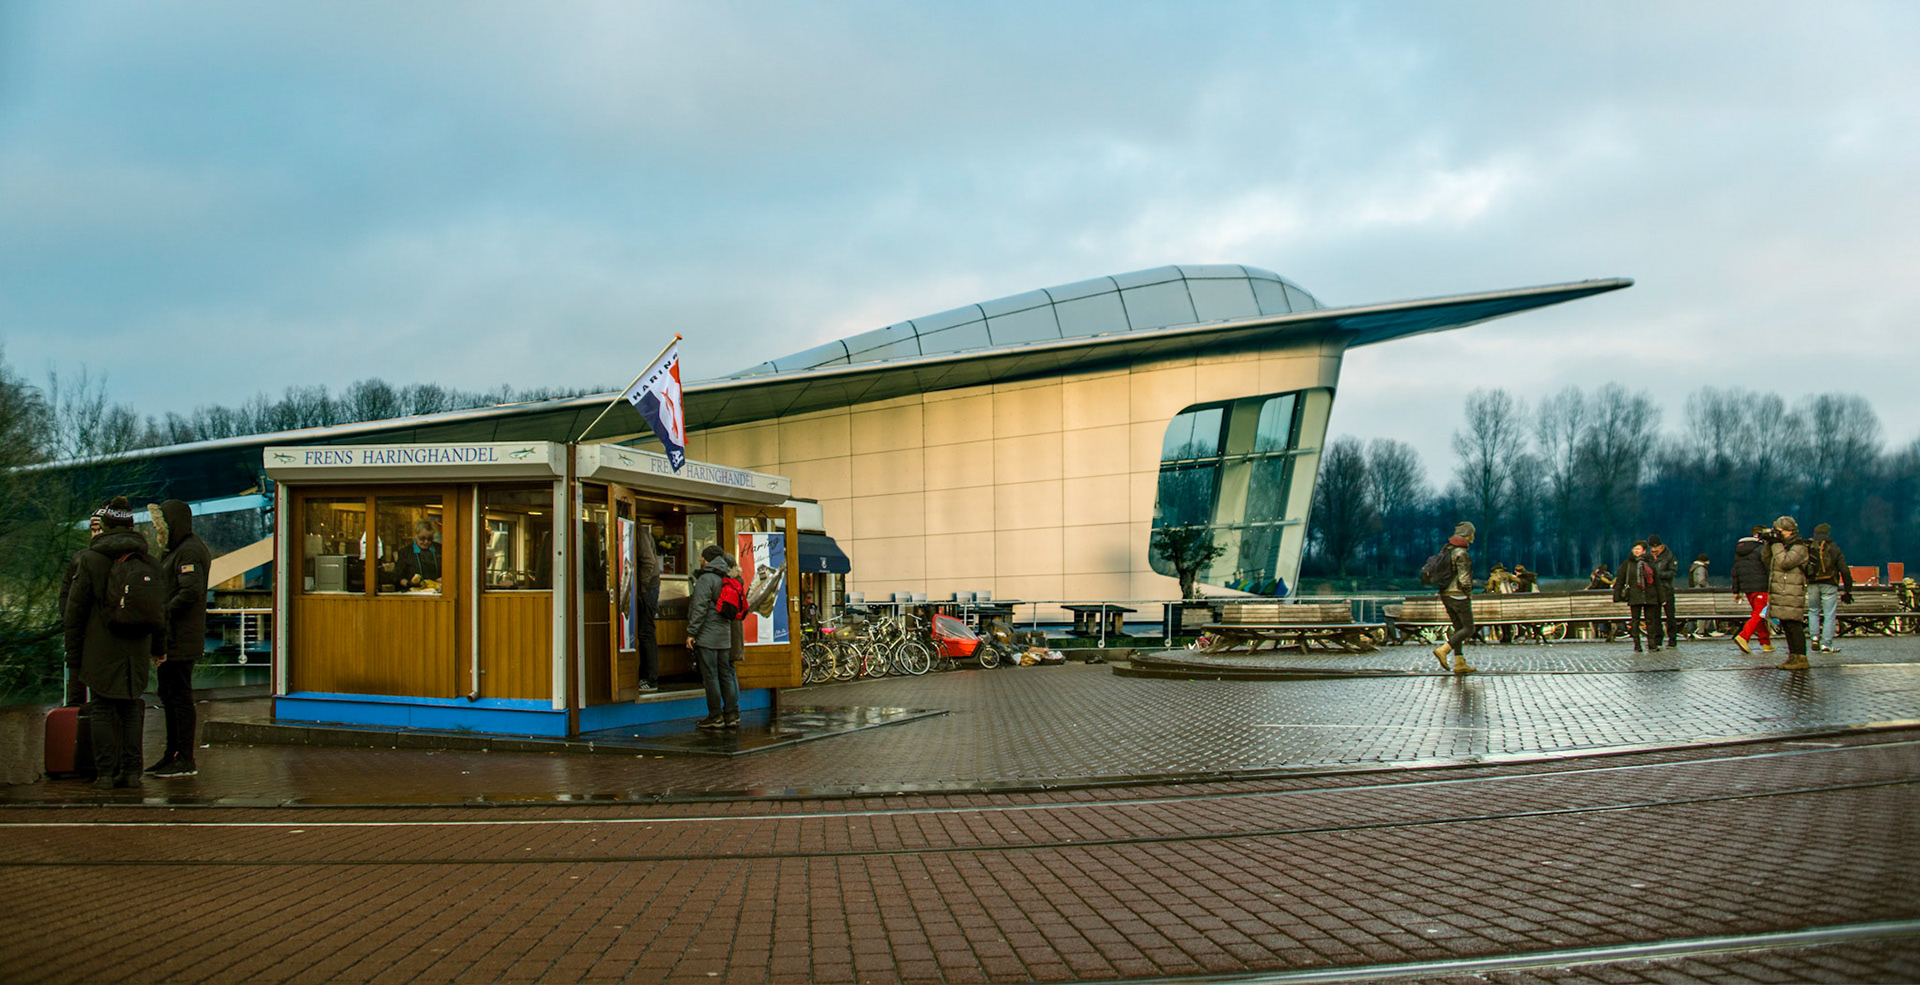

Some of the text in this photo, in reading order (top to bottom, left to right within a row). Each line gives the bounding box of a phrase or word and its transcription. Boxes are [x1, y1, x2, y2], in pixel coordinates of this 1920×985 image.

[305, 447, 499, 465] FRENS HARINGHANDEL
[650, 458, 756, 488] FRES HARINGHANDEL
[740, 536, 780, 558] Haring
